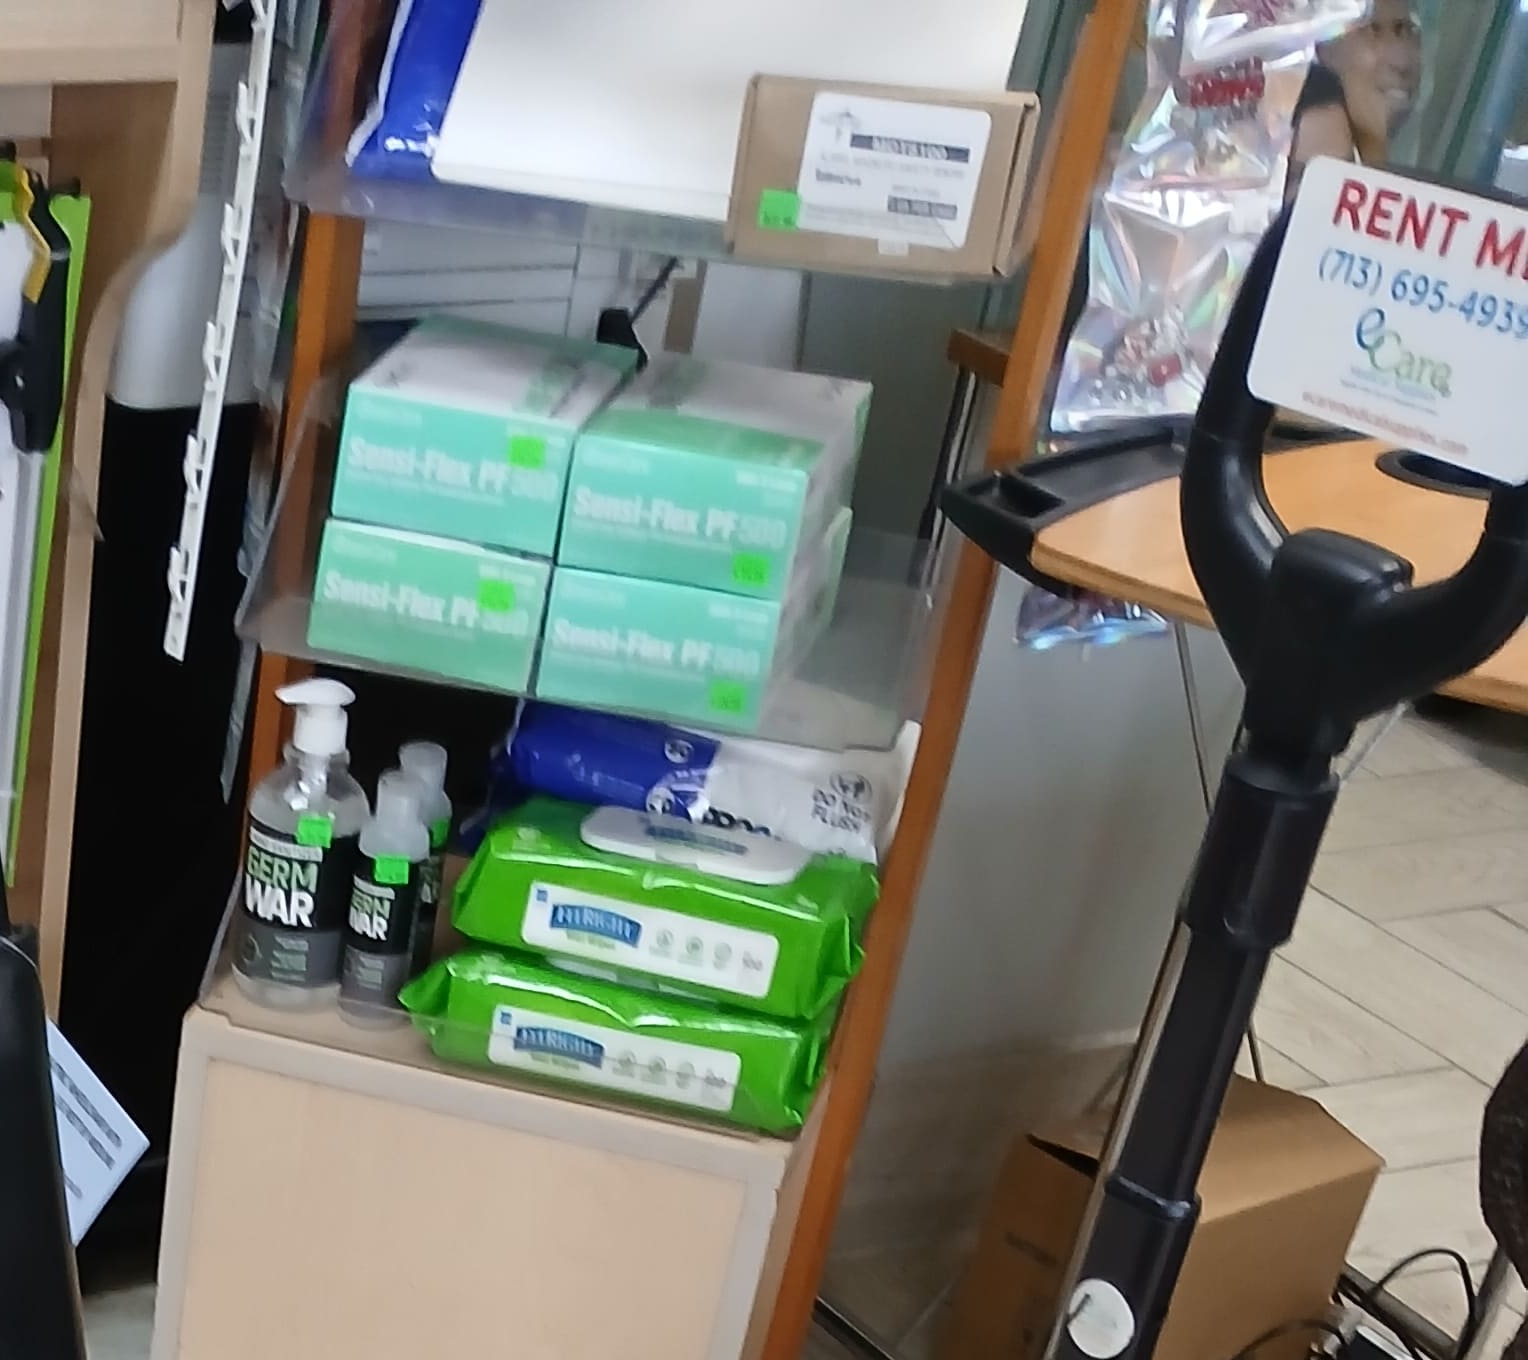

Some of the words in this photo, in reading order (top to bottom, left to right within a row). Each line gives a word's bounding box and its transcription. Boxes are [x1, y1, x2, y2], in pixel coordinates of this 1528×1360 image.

[1332, 178, 1469, 257] RENT
[1475, 218, 1528, 281] M
[1319, 247, 1383, 296] (713)
[1355, 306, 1452, 398] eCare
[574, 484, 699, 536] Sensi-Flex
[246, 844, 319, 894] GERM
[245, 874, 315, 929] WAR
[348, 910, 389, 942] WAR
